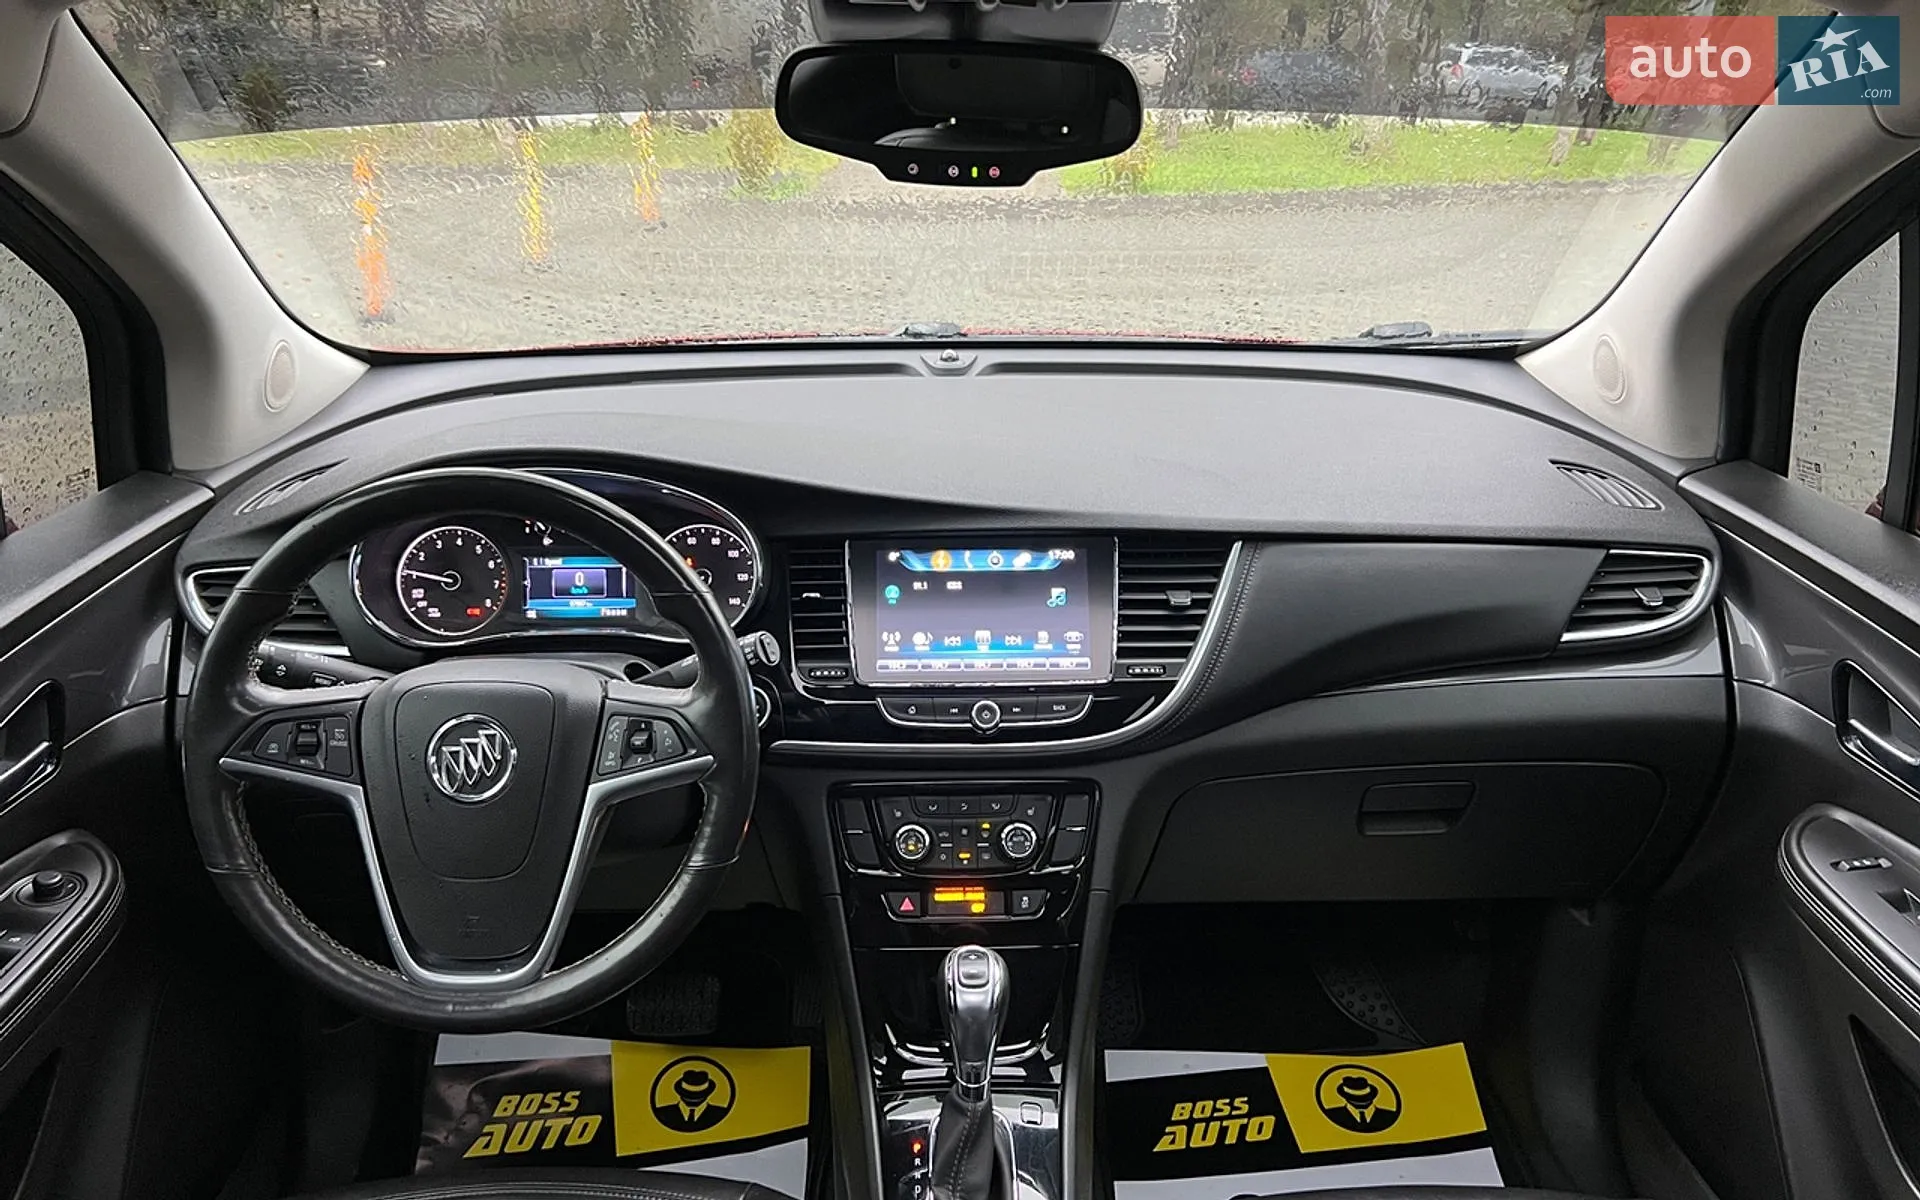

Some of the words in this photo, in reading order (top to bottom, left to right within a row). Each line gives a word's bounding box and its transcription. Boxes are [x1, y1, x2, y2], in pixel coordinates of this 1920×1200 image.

[435, 540, 442, 549] 3
[456, 538, 463, 546] 4
[475, 545, 482, 554] 5
[727, 549, 740, 558] 100
[418, 551, 426, 561] 2
[487, 560, 495, 569] 6
[574, 571, 584, 586] 0
[493, 580, 499, 589] 7
[492, 1090, 582, 1118] BOSS
[1170, 1096, 1250, 1121] BOSS
[462, 1114, 603, 1159] AUTO
[1152, 1115, 1277, 1152] AUTO
[914, 1158, 921, 1166] R
[914, 1185, 921, 1194] D
